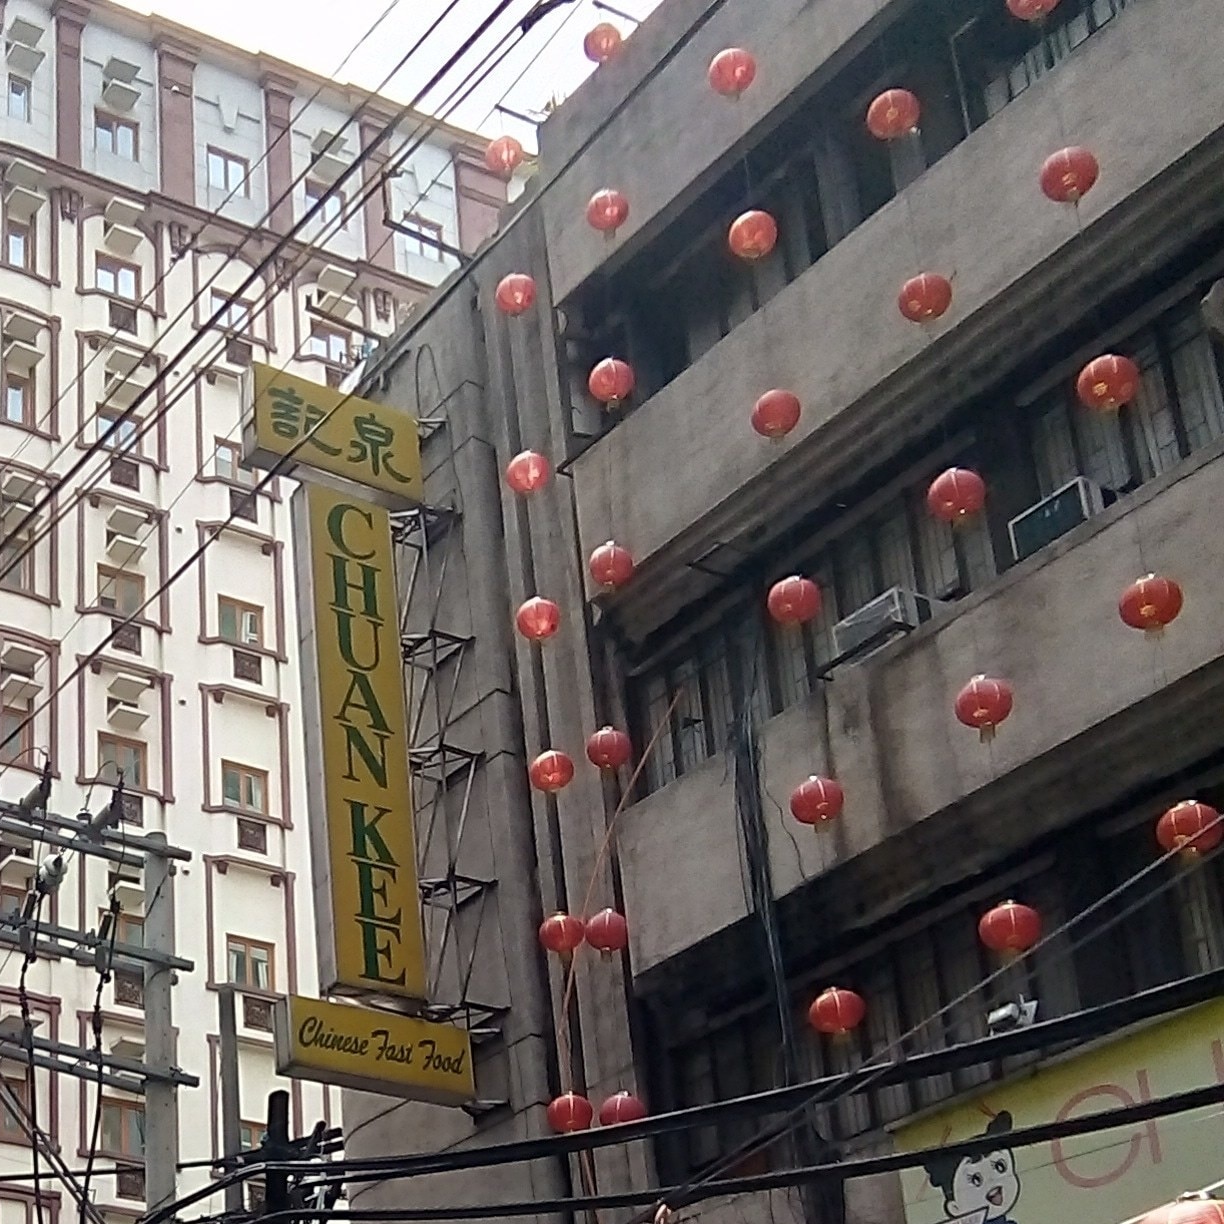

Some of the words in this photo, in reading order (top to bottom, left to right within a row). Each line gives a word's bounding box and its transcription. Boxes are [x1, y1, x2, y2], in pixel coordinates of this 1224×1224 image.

[326, 503, 396, 789] CHUAN
[343, 798, 406, 987] KEE
[298, 1016, 369, 1056] Chinese
[371, 1029, 413, 1065] Fast
[418, 1039, 466, 1075] Food
